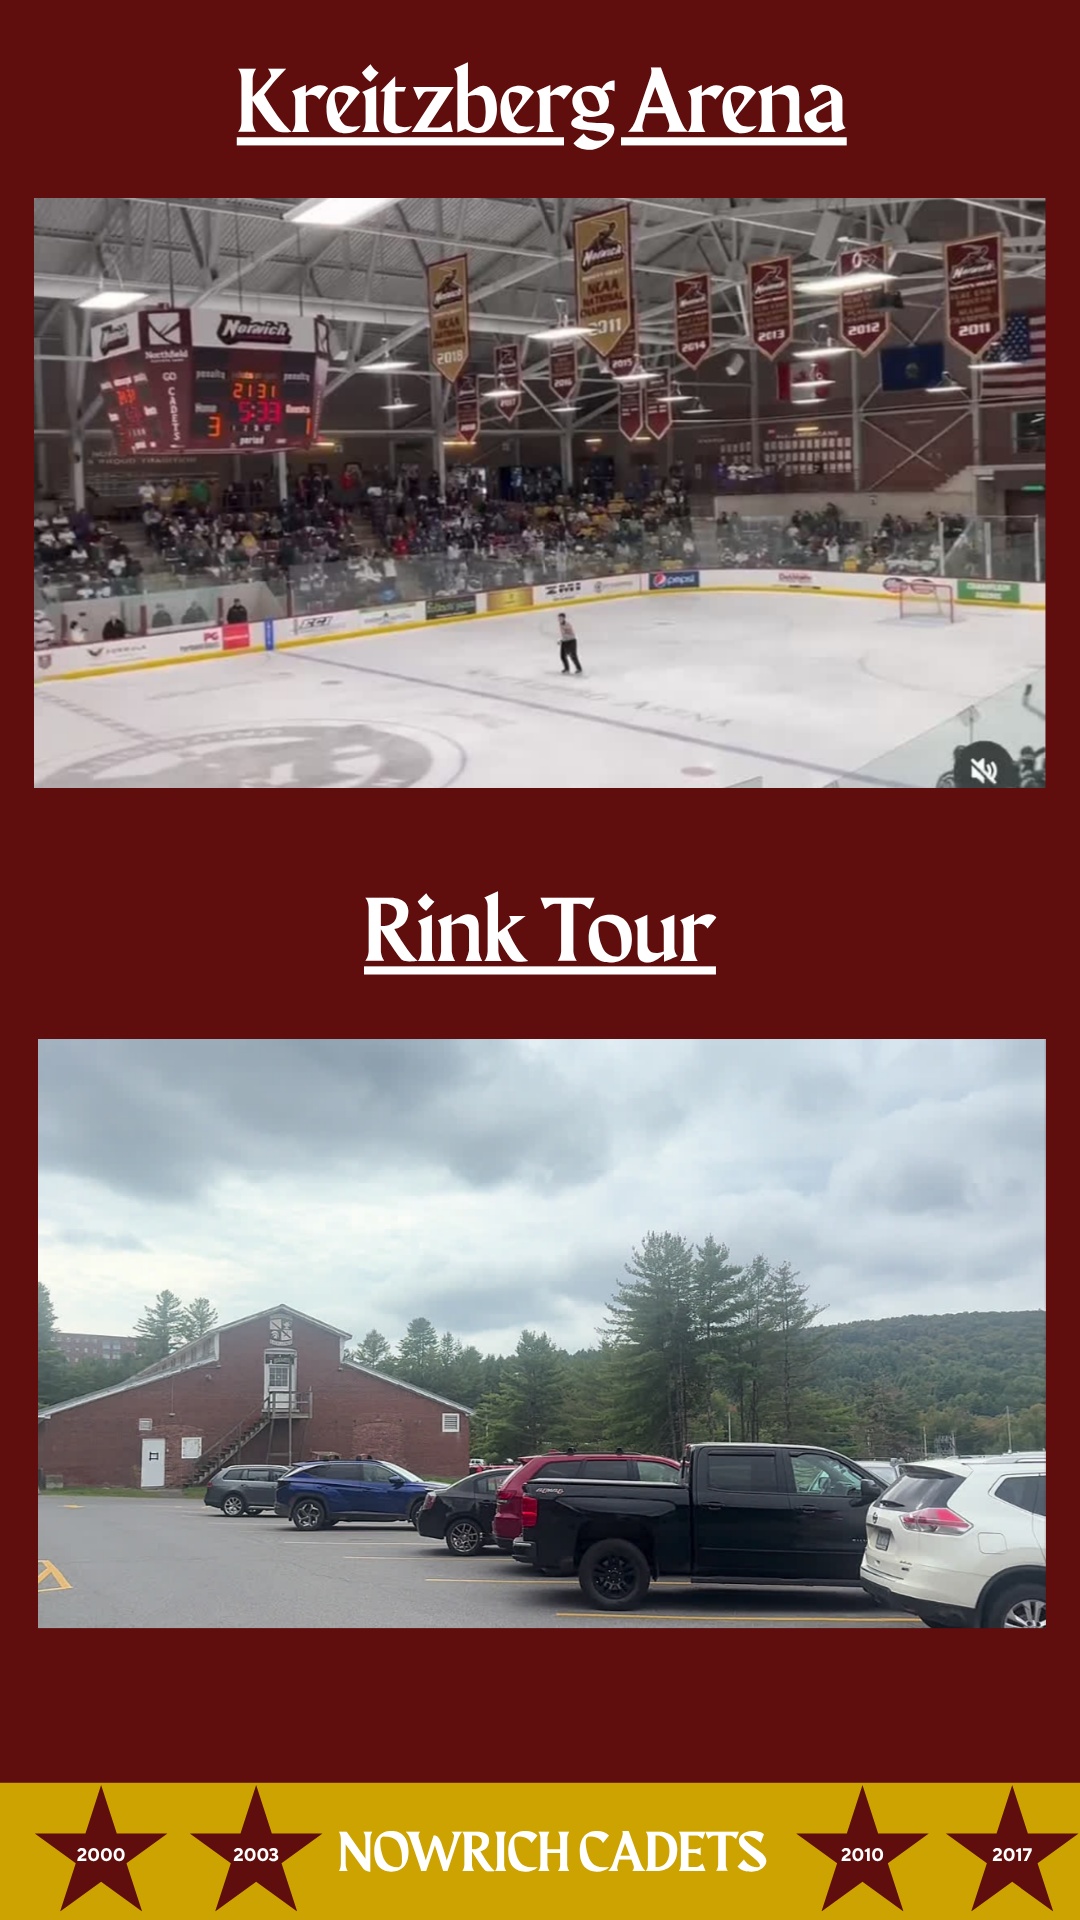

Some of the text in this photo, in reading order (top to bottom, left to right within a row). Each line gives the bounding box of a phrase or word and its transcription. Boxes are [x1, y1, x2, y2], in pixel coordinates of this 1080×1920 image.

[587, 278, 619, 295] NCAA
[221, 318, 290, 339] Norwich
[848, 322, 880, 336] 2012
[958, 322, 990, 337] 2011
[758, 329, 785, 342] 2013
[682, 340, 706, 353] 2014
[162, 371, 178, 381] GO
[196, 370, 226, 380] penalty
[283, 372, 310, 382] penalty
[167, 386, 182, 441] CADETS
[208, 415, 221, 437] 3
[240, 436, 264, 445] period
[667, 574, 695, 586] pepsi
